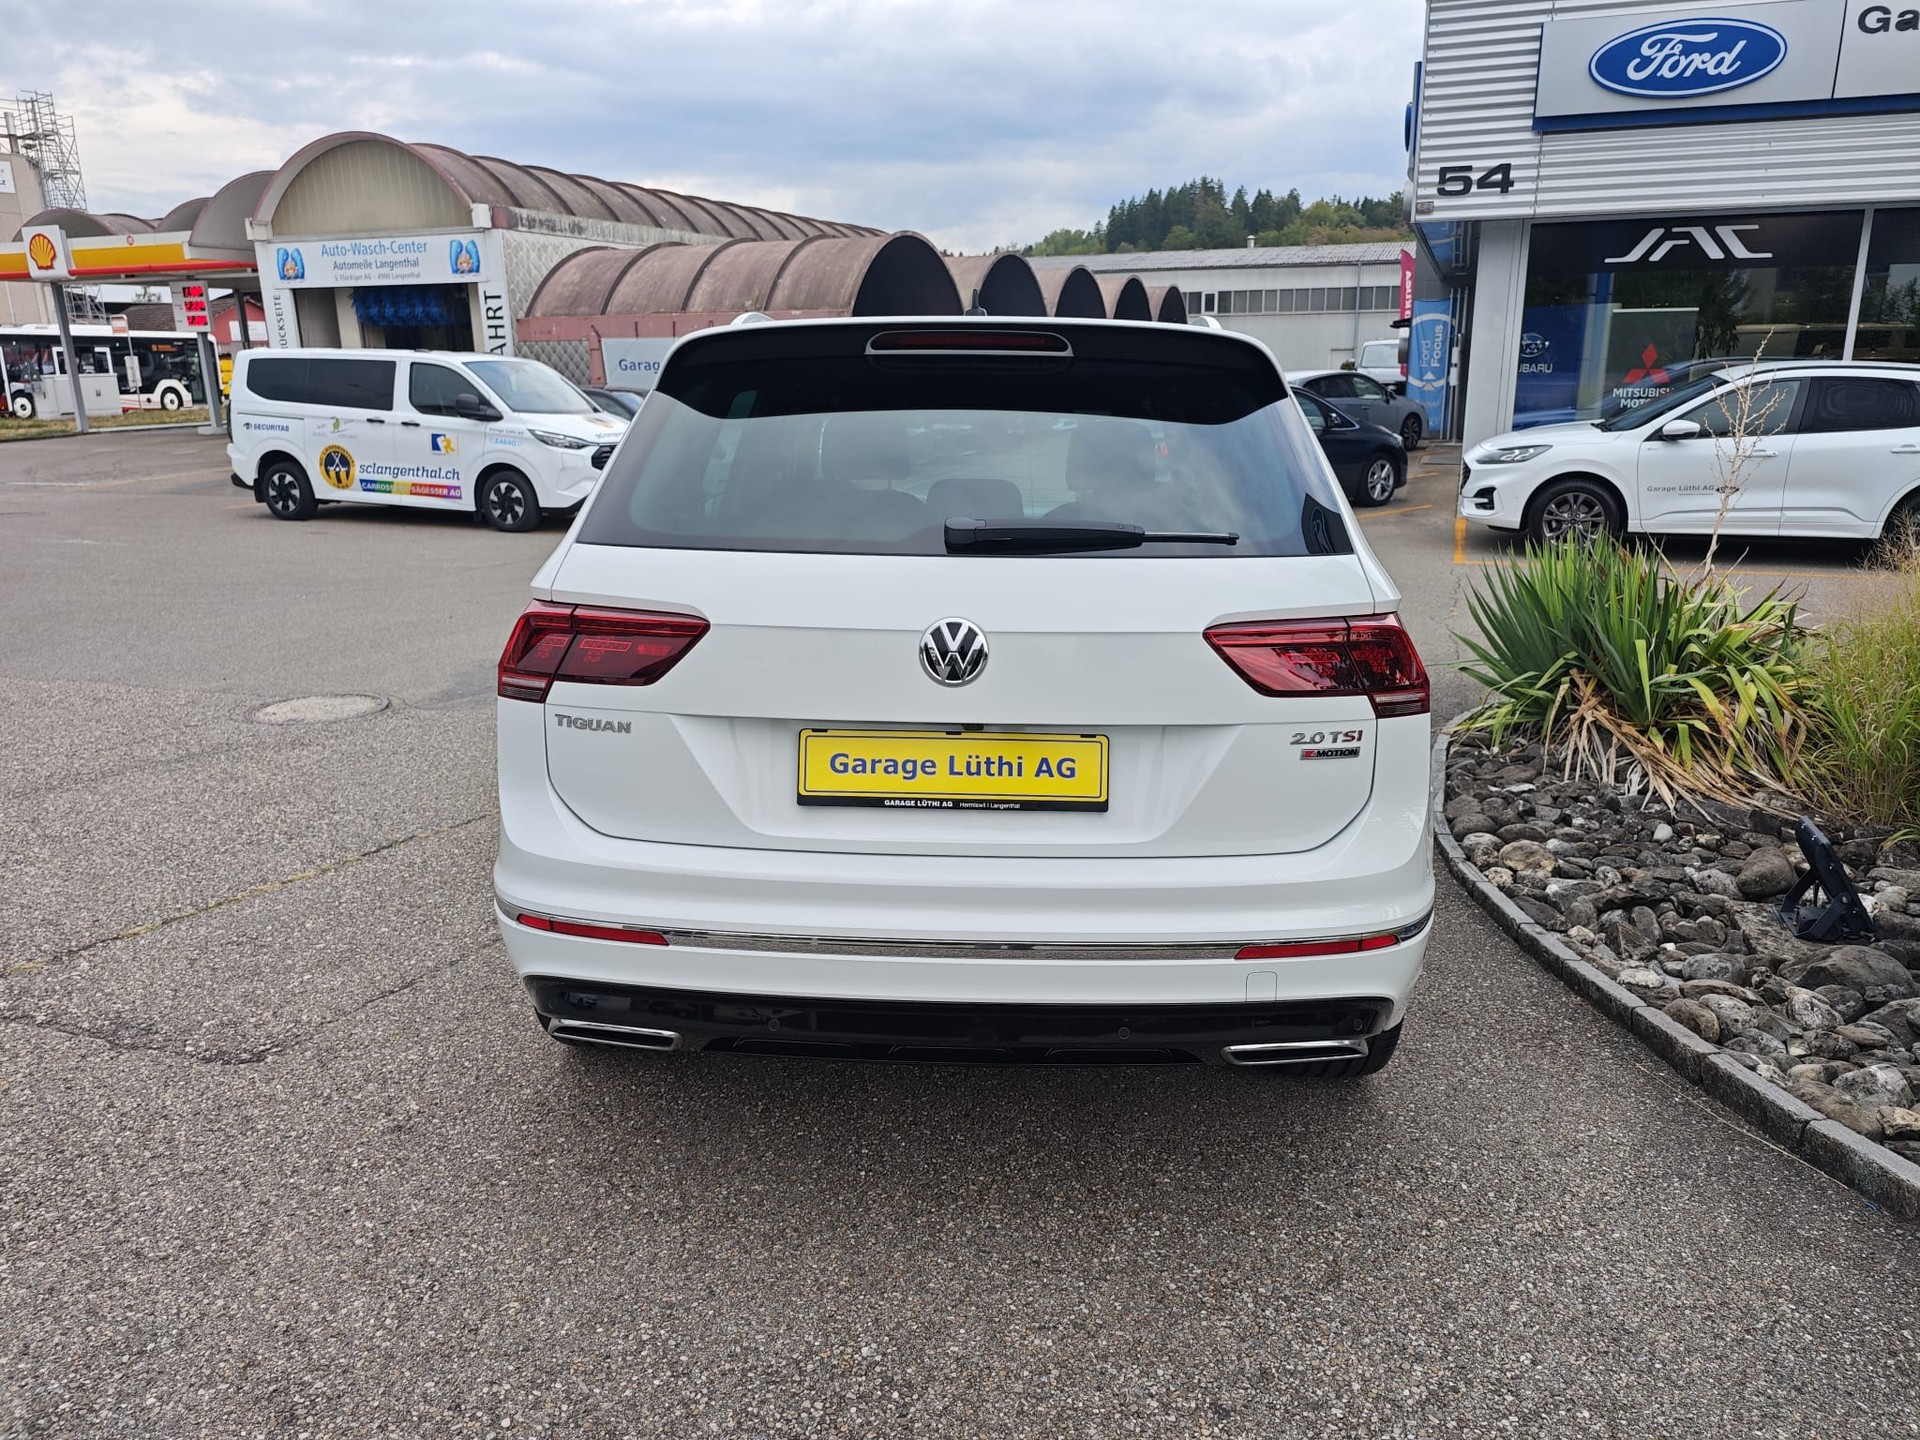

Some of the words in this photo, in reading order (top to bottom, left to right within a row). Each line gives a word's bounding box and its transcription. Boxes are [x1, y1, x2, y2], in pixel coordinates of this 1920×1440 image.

[1857, 5, 1920, 34] Ga
[1626, 31, 1747, 81] Ford
[1437, 163, 1515, 196] 54
[321, 240, 428, 257] Auto-Wasch-Center
[1604, 224, 1773, 263] JAC
[333, 259, 373, 271] Automeile
[375, 256, 420, 271] Langenthal
[1431, 324, 1444, 367] Focus
[1420, 340, 1430, 368] Ford
[618, 359, 660, 374] Garag
[1519, 363, 1553, 373] BARU
[1612, 387, 1674, 398] MITSUBIS
[1620, 398, 1651, 408] MOT
[253, 423, 290, 432] SECURITAS
[359, 462, 460, 480] sclangenthal.ch
[449, 488, 461, 497] AG
[1646, 485, 1676, 493] Garage
[1678, 484, 1700, 492] Lüthi
[554, 713, 632, 734] TIGUAN
[1290, 731, 1325, 745] 2.0
[1329, 729, 1363, 743] TSI
[829, 752, 937, 781] Garage
[948, 754, 1023, 778] Lüthi
[1034, 756, 1077, 779] AG
[884, 799, 915, 807] GARAGE
[917, 799, 941, 807] LÜTHI
[942, 800, 953, 808] AG
[990, 802, 1021, 810] Langenthal
